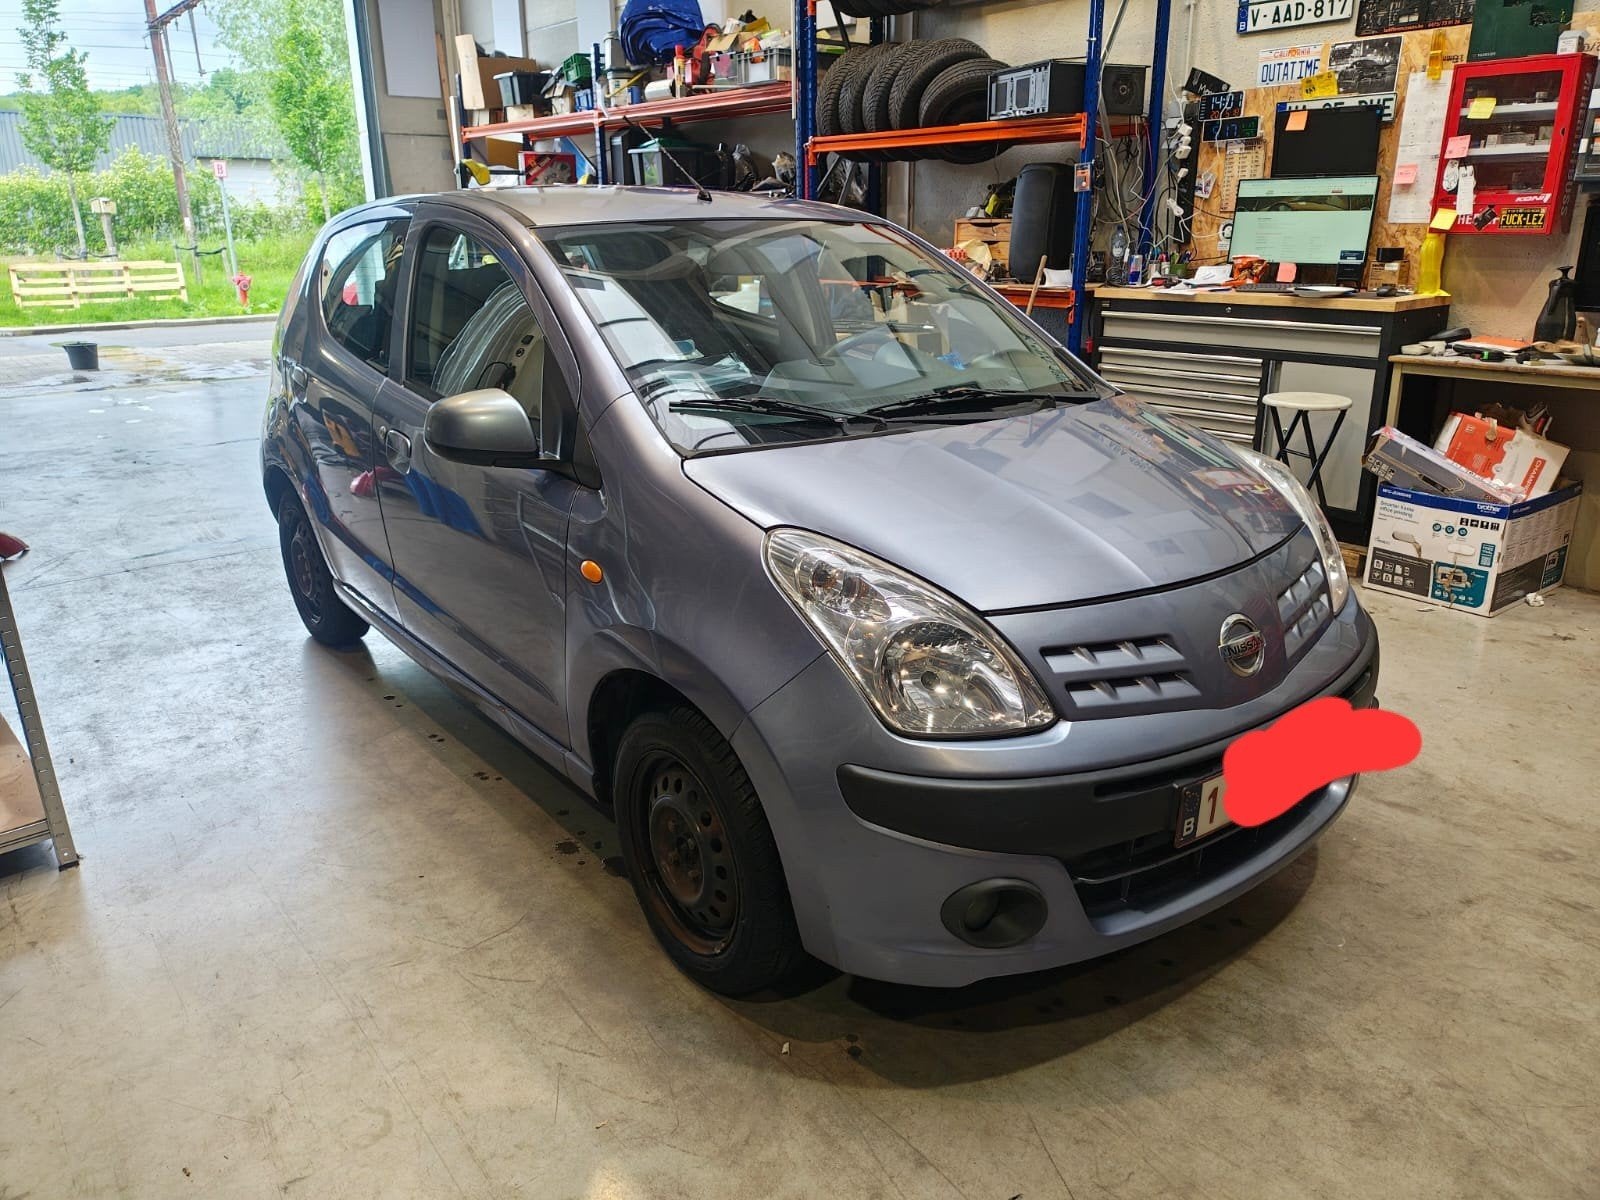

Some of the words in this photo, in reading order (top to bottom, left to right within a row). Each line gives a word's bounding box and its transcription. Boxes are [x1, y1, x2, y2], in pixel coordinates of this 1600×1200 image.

[1252, 0, 1347, 27] V-AAD-817
[1273, 47, 1311, 58] CALIFORNIA
[1500, 213, 1545, 225] FUCK-LEZ
[1477, 503, 1501, 513] brother
[1226, 634, 1265, 659] NISSAN
[1182, 818, 1195, 836] B
